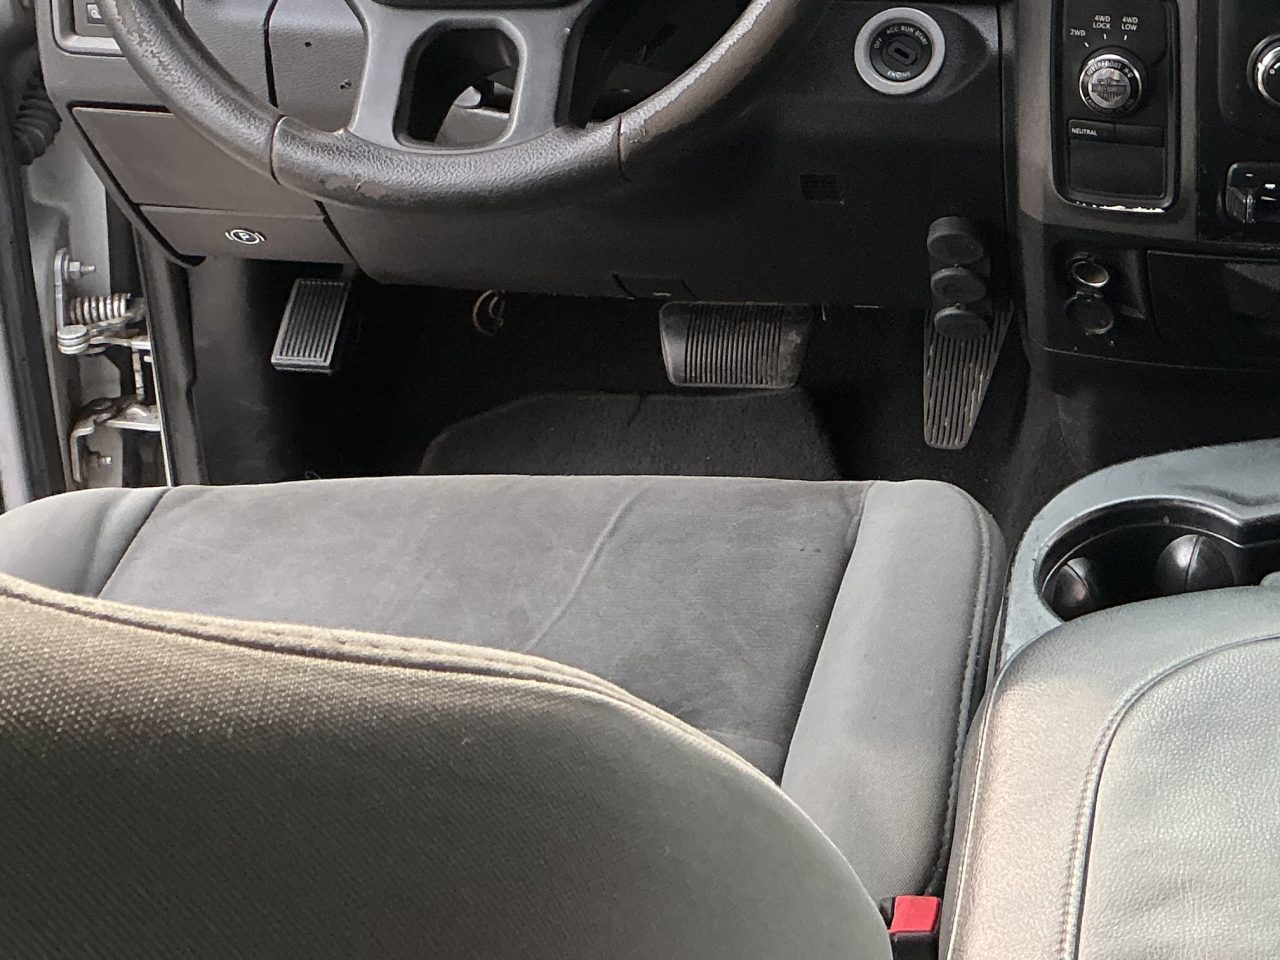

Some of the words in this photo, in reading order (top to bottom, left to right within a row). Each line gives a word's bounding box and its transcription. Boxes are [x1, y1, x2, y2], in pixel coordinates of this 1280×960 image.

[1094, 15, 1111, 23] 4WD
[1121, 16, 1138, 24] 4WD
[886, 26, 899, 34] ACC
[901, 25, 914, 33] RUN
[1092, 22, 1111, 30] LOCK
[1121, 23, 1137, 31] LOW
[1070, 29, 1086, 37] 2WD
[1071, 127, 1098, 137] NEUTRAL
